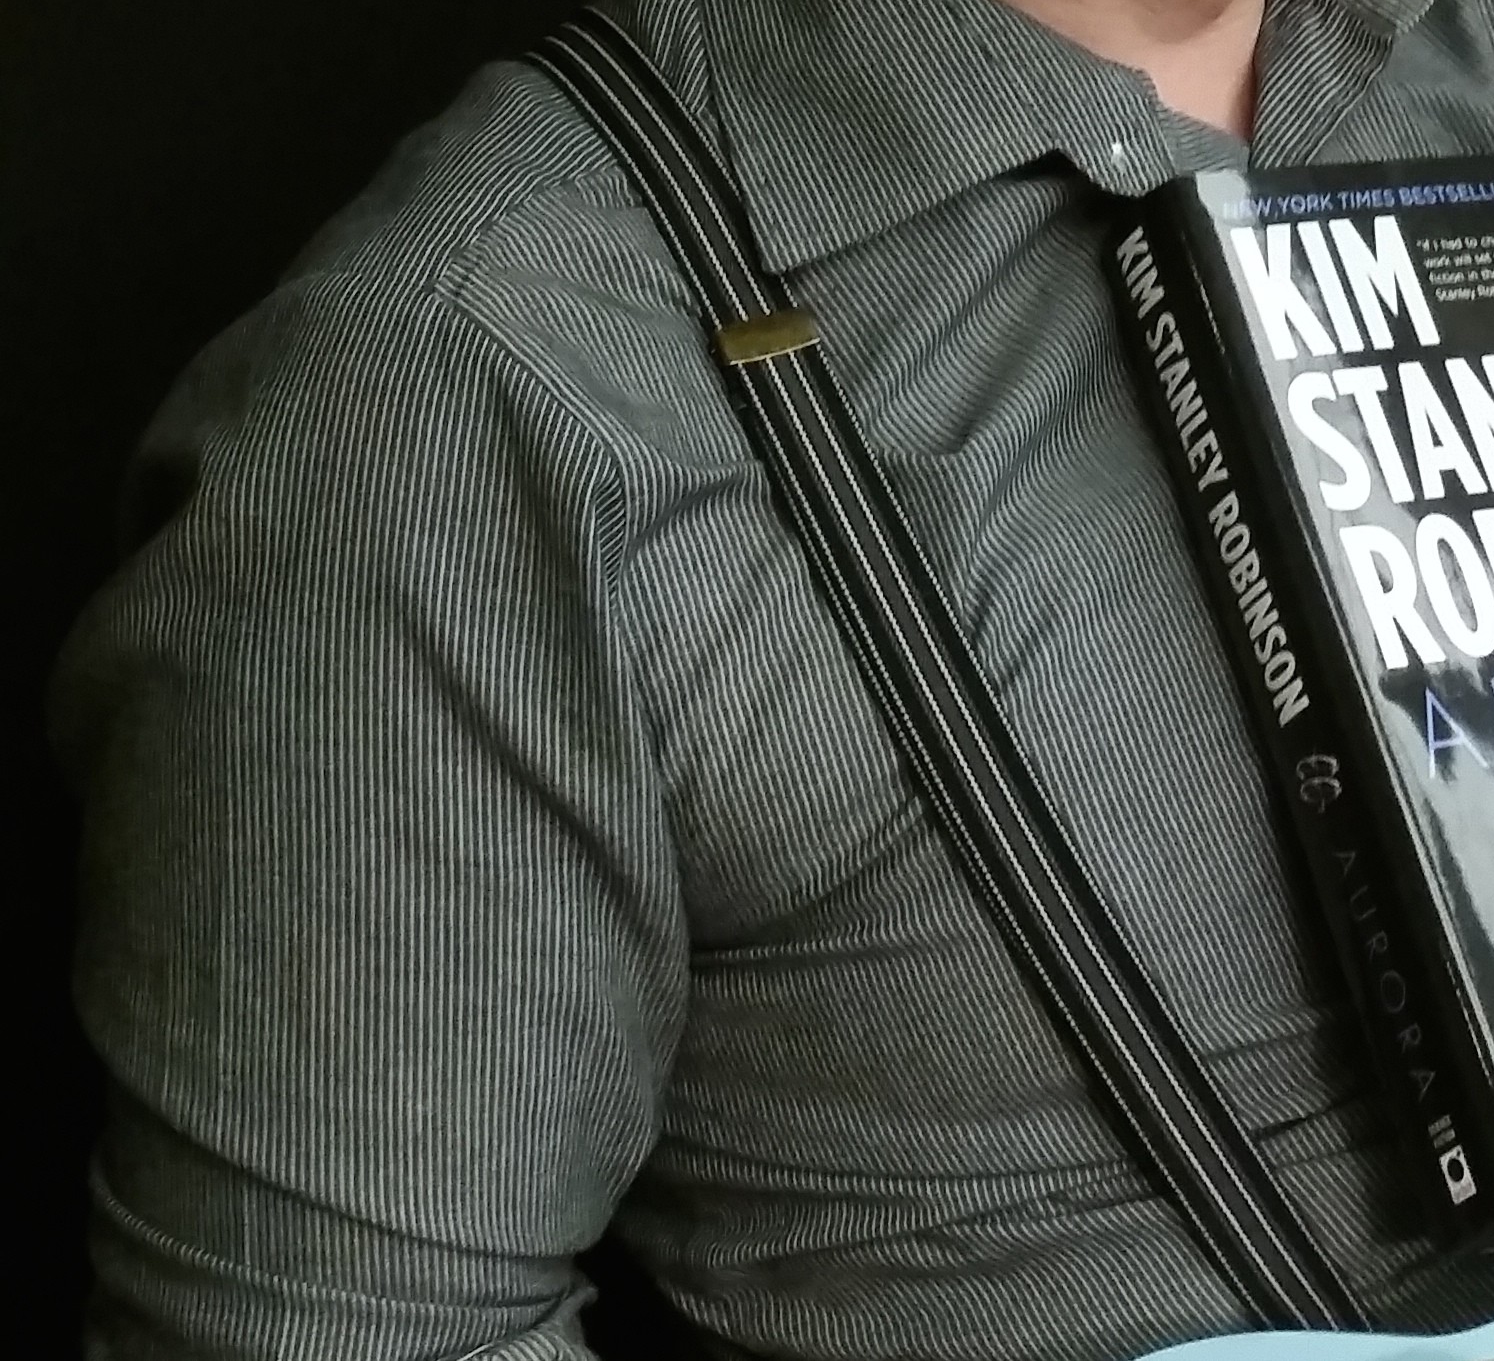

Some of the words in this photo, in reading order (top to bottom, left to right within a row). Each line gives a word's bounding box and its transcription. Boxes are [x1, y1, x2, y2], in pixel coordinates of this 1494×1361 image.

[1276, 191, 1334, 216] YORK
[1338, 188, 1395, 211] TIMES
[1440, 236, 1463, 251] had
[1464, 235, 1478, 249] to
[1424, 254, 1451, 269] work
[1453, 252, 1472, 267] will
[1474, 250, 1492, 265] set
[1428, 270, 1465, 285] fiction
[1467, 269, 1479, 282] in
[1230, 215, 1441, 361] KIM
[1435, 287, 1476, 302] Stanley
[1116, 225, 1164, 320] KIM
[1145, 310, 1230, 494] STANLEY
[1208, 490, 1310, 729] ROBINSON
[1330, 849, 1436, 1103] AURORA
